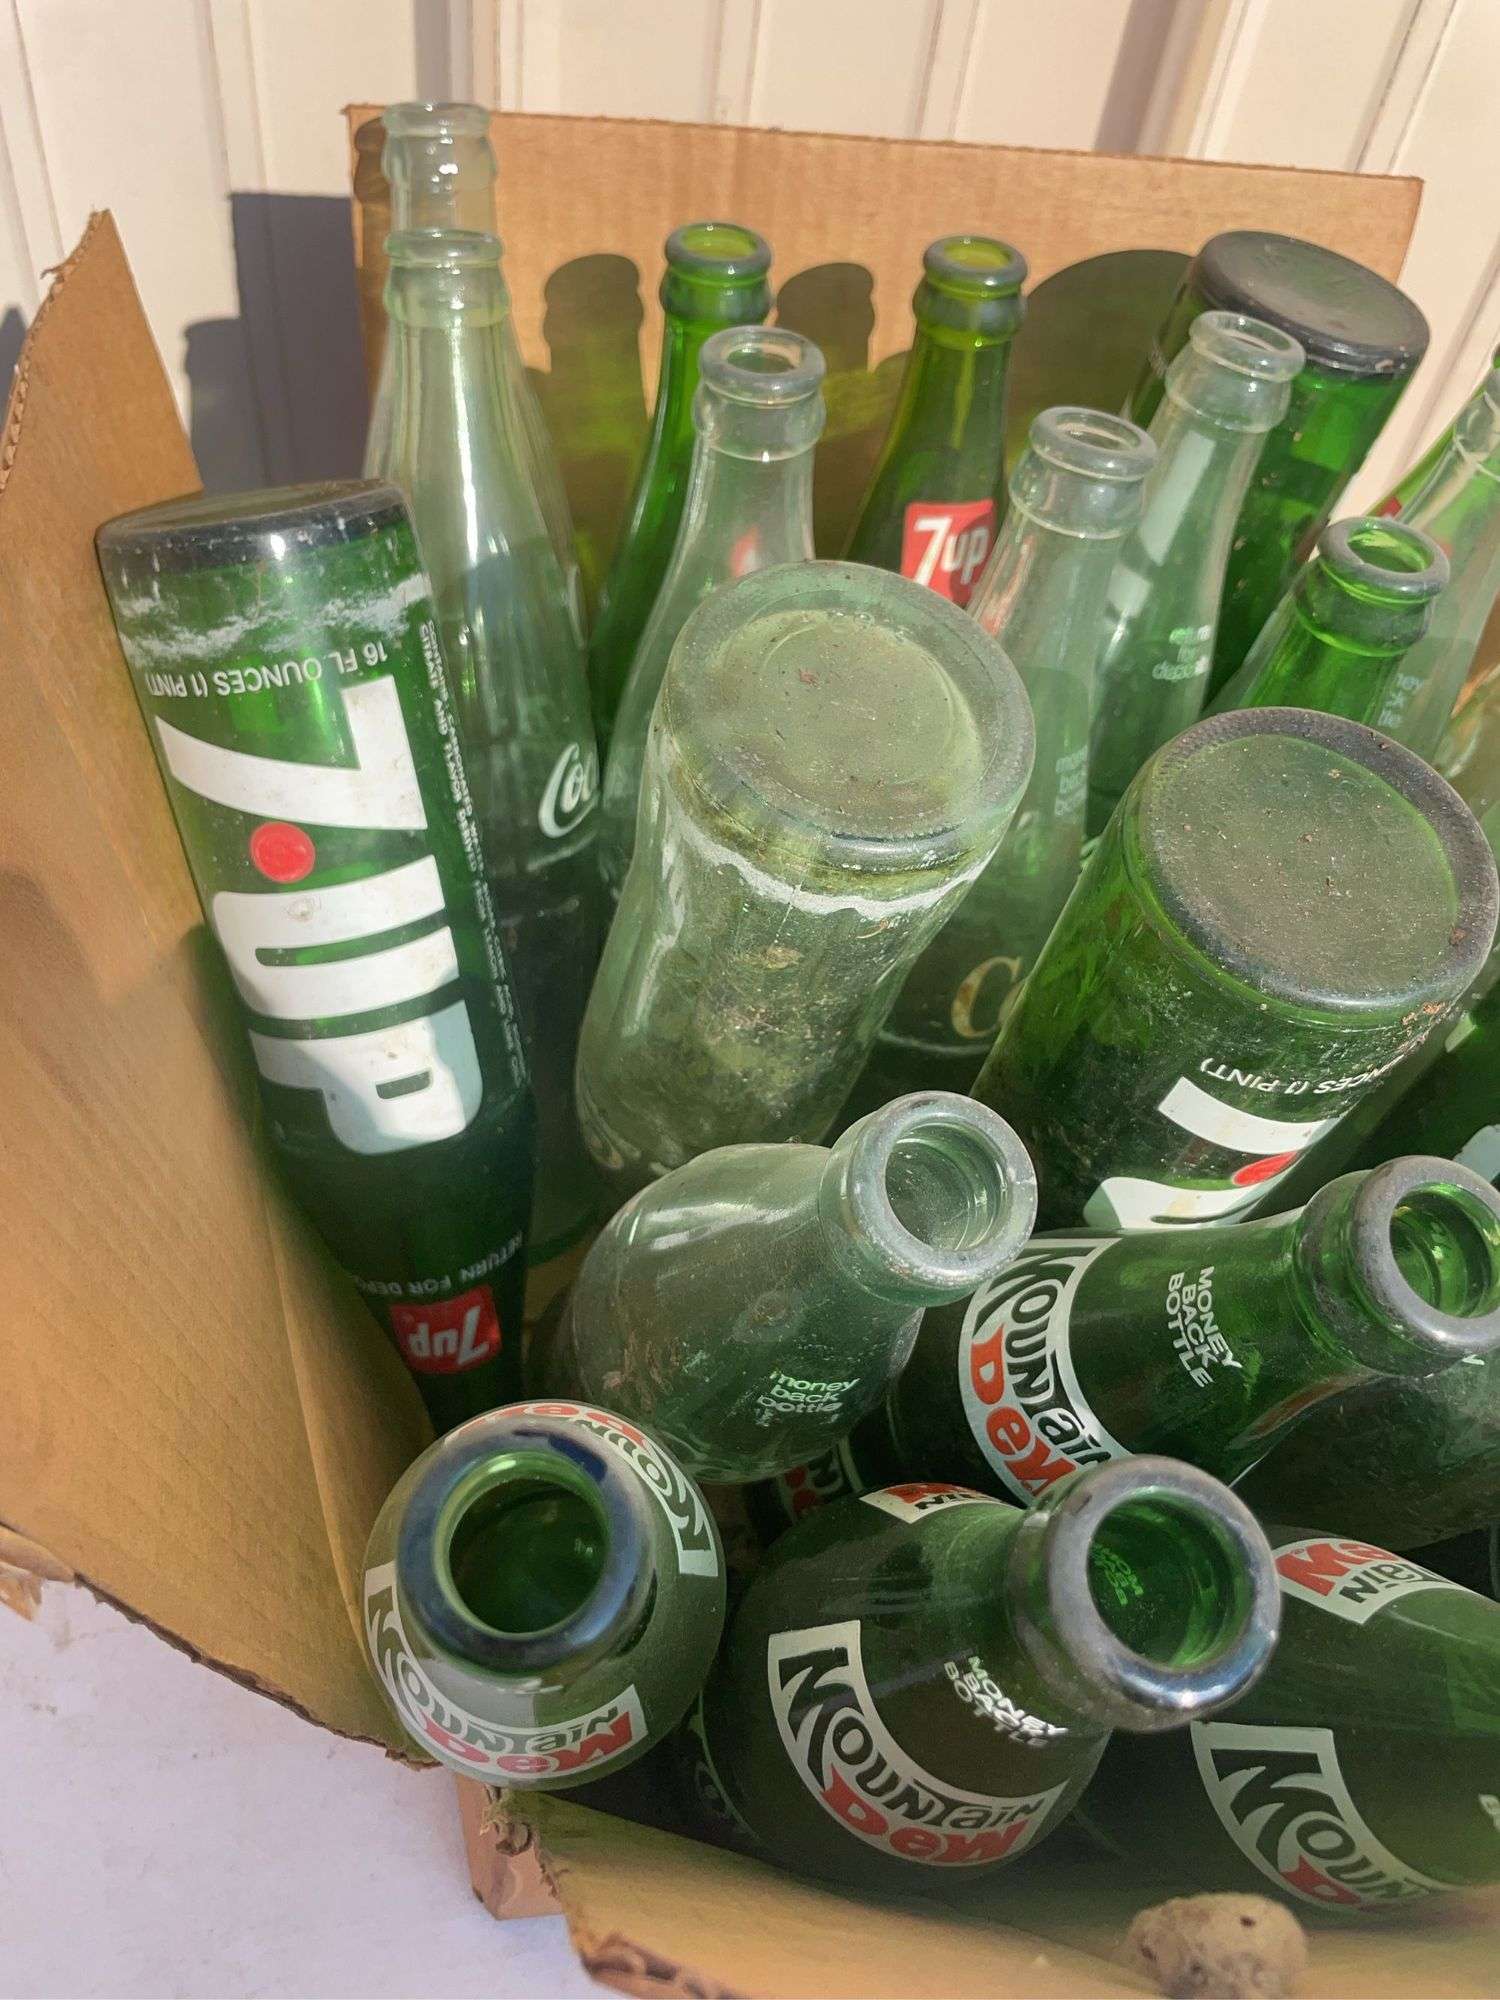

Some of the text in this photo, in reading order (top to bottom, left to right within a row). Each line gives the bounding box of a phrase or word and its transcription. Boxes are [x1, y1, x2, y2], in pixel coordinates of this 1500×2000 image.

[913, 515, 990, 586] 7up
[362, 640, 388, 667] 16
[144, 671, 186, 698] PINT)
[190, 670, 209, 698] (1
[212, 657, 321, 696] OUNCES
[433, 698, 448, 735] AND
[444, 742, 462, 802] FLAVOR
[1200, 1057, 1280, 1093] PINT)
[408, 1274, 452, 1297] FOR
[406, 1304, 490, 1366] 7up
[1166, 1272, 1215, 1388] BOTTLE
[1182, 1284, 1219, 1368] BACK
[1197, 1266, 1243, 1368] MONEY
[770, 1384, 841, 1403] back
